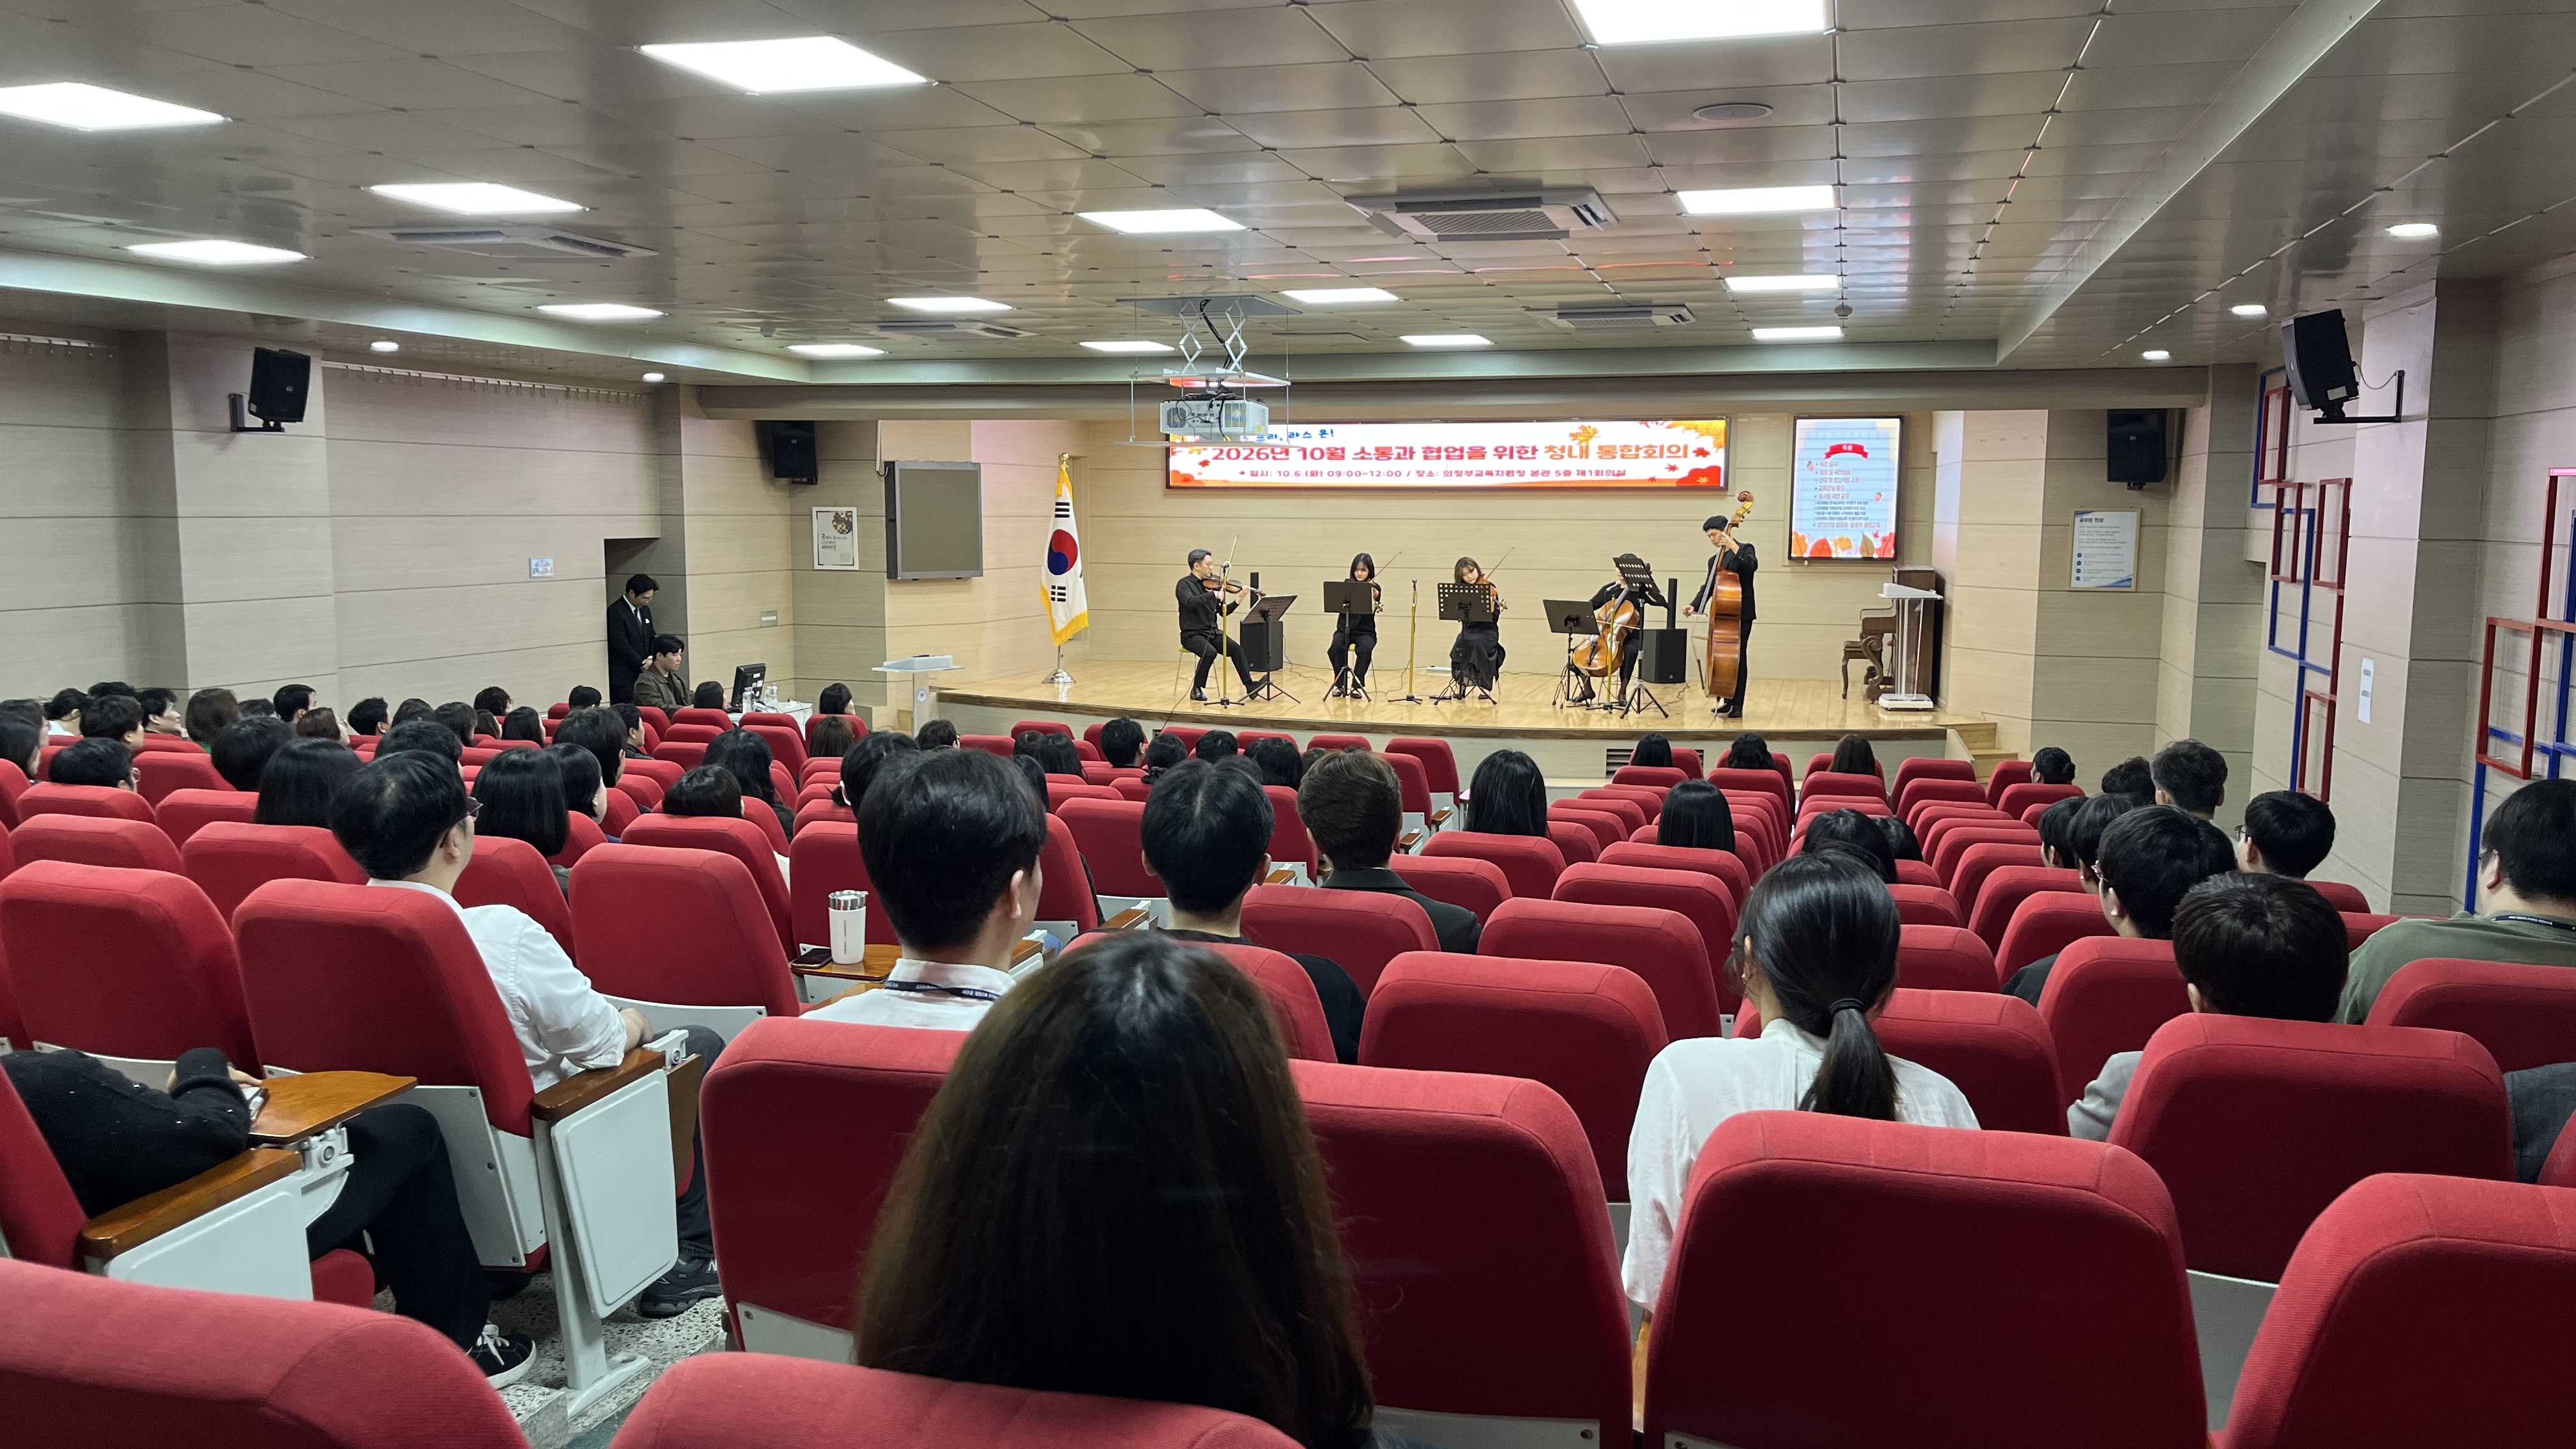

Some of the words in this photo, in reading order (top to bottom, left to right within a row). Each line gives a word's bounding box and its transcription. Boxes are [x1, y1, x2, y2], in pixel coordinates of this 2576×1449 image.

[1211, 447, 1290, 461] 2026년
[1297, 446, 1346, 461] 10월
[1352, 446, 1416, 461] 소통과
[1421, 446, 1487, 460] 협업을
[1493, 445, 1538, 460] 위한
[1544, 445, 1589, 460] 청내
[1597, 444, 1689, 460] 통합회의
